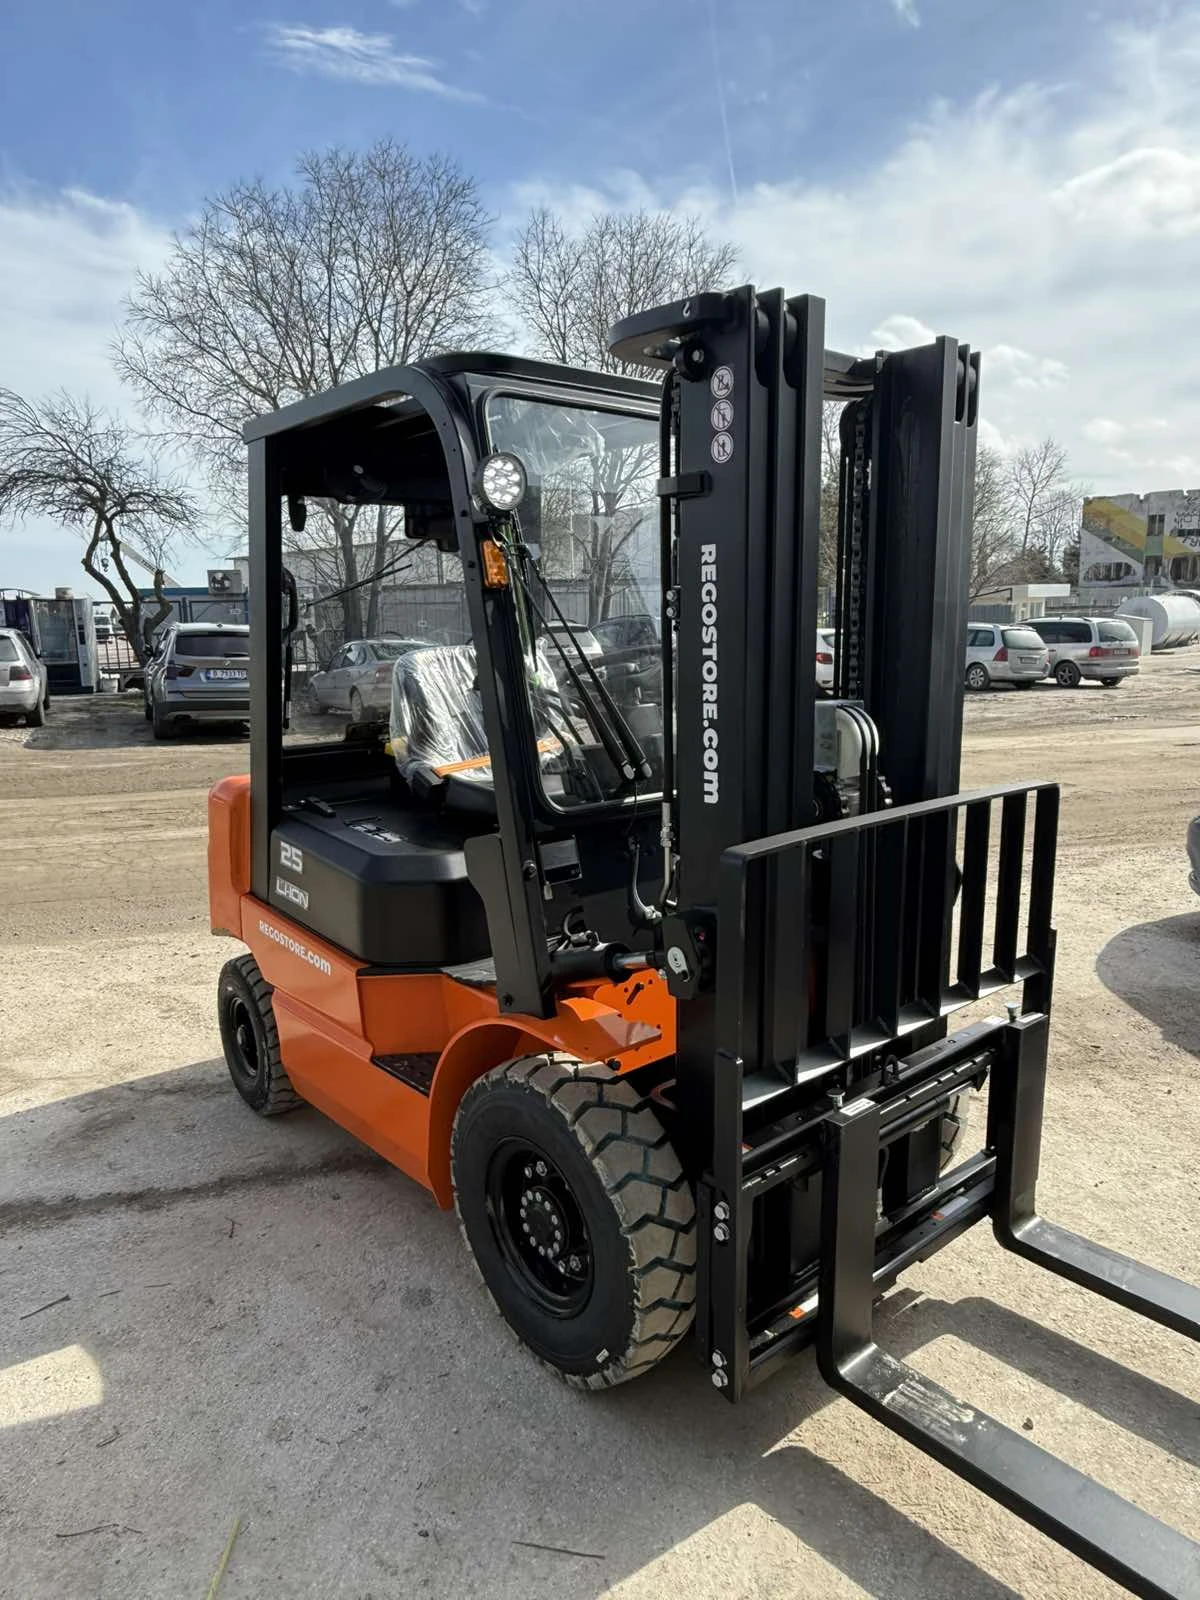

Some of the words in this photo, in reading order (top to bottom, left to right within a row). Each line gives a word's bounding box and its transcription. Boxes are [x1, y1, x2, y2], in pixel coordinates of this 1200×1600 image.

[701, 543, 719, 804] REGOSTORE.com
[279, 841, 303, 874] 25
[259, 919, 331, 976] REGOSTORE.com
